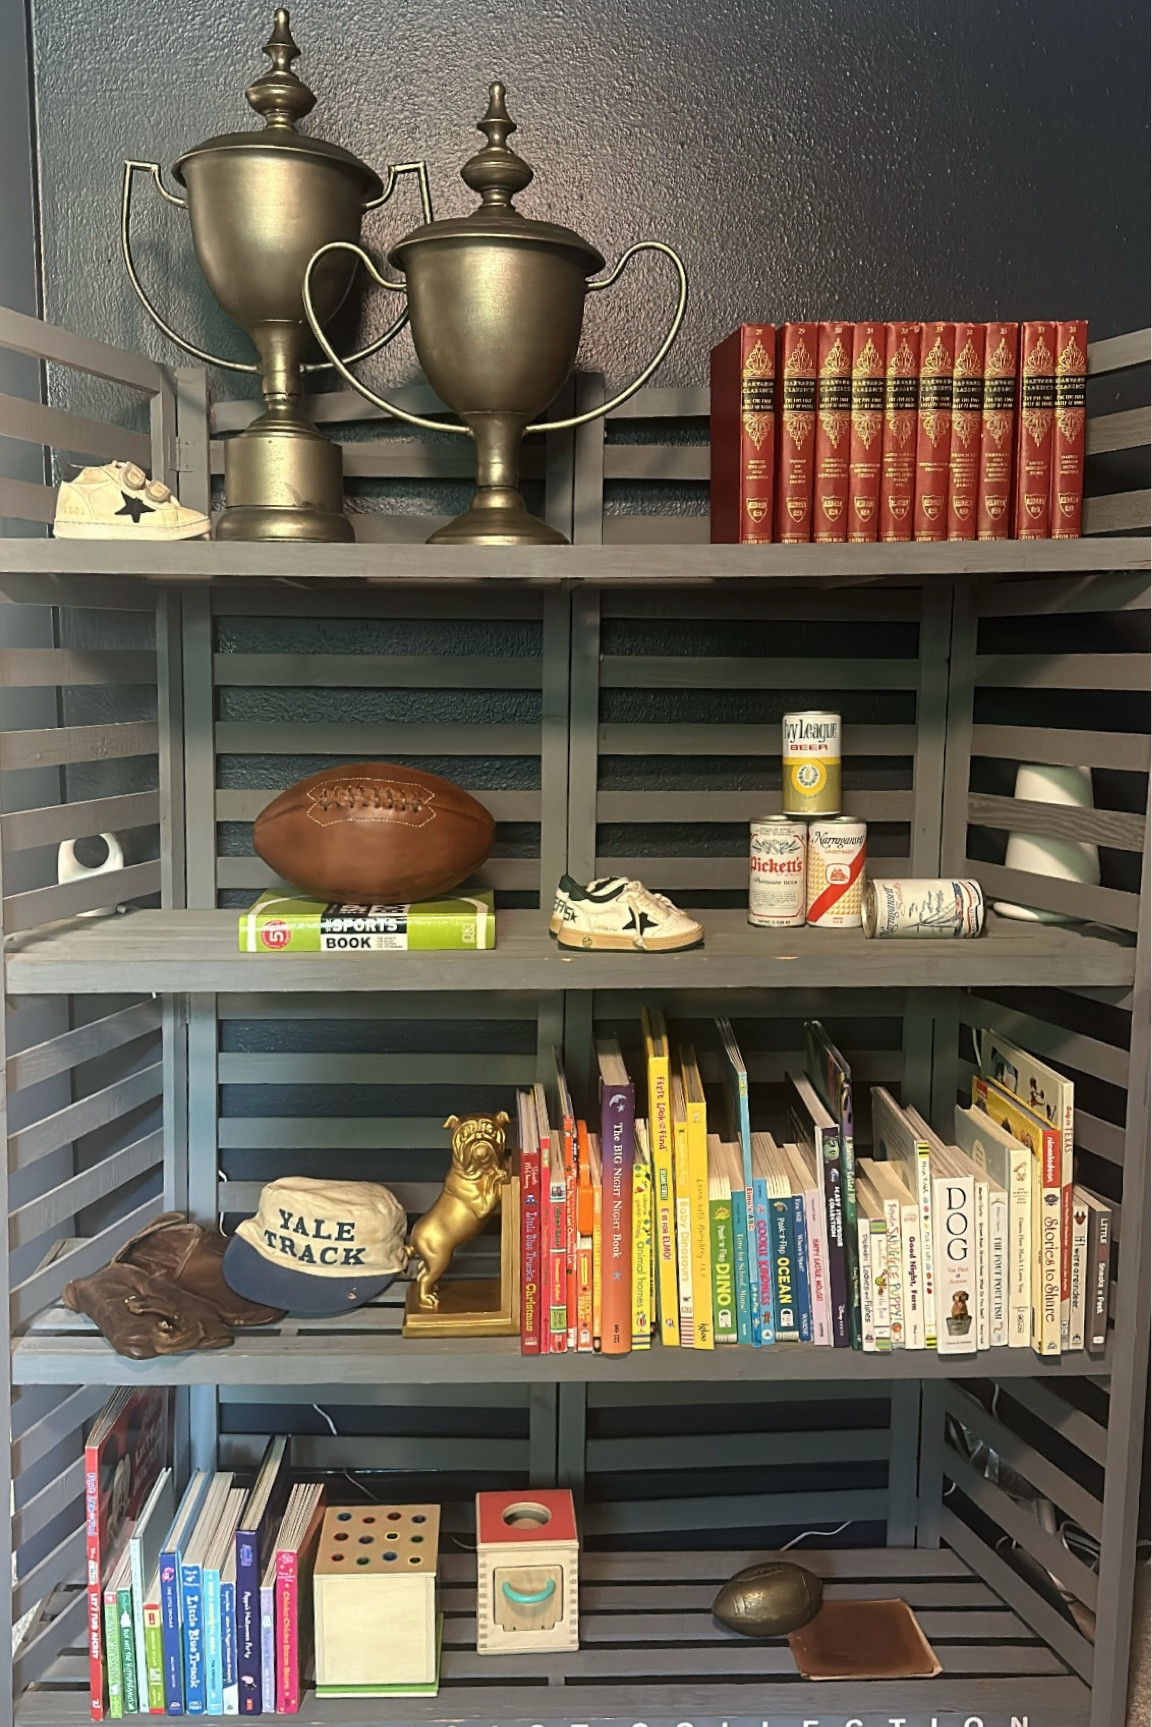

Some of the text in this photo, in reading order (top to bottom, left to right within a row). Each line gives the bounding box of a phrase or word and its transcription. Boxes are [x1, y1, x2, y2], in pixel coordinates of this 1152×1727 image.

[799, 719, 838, 743] League
[332, 917, 398, 932] SPORTS
[326, 936, 372, 949] BOOK
[613, 1122, 623, 1141] The
[1064, 1127, 1073, 1153] TEXAS
[613, 1144, 623, 1164] BIG
[1045, 1136, 1055, 1183] nickelodeon
[678, 1200, 689, 1229] Baby
[746, 1187, 755, 1231] Elmo's ABC
[829, 1197, 837, 1238] COLLECTION
[278, 1208, 356, 1242] YALE
[661, 1222, 669, 1234] FOR
[946, 1187, 969, 1261] DOG
[1099, 1217, 1108, 1244] LITTLE
[263, 1229, 367, 1266] TRACK
[612, 1233, 622, 1258] Book
[662, 1235, 671, 1260] ELMO!
[736, 1233, 745, 1251] Time
[812, 1238, 821, 1257] HAPPY
[679, 1231, 690, 1282] Dinosaurs
[737, 1252, 745, 1261] for
[1044, 1216, 1059, 1322] Stories to Share
[525, 1211, 538, 1332] Little Blue Truck's Christmas
[715, 1262, 731, 1306] DINO
[757, 1260, 771, 1306] KINDNESS
[776, 1256, 792, 1304] OCEAN
[862, 1265, 871, 1291] Loaves
[886, 1226, 902, 1321] SNUGGLE PUPPY!
[908, 1260, 917, 1287] Night,
[1096, 1262, 1106, 1288] Sneaks
[635, 1276, 646, 1308] homes
[910, 1290, 918, 1311] Farm
[1096, 1296, 1105, 1314] Peek
[864, 1300, 872, 1323] Fishes
[699, 1323, 709, 1342] igloo
[243, 1591, 253, 1659] Peppa's Halloween Party
[186, 1595, 200, 1688] Little Blue Truck
